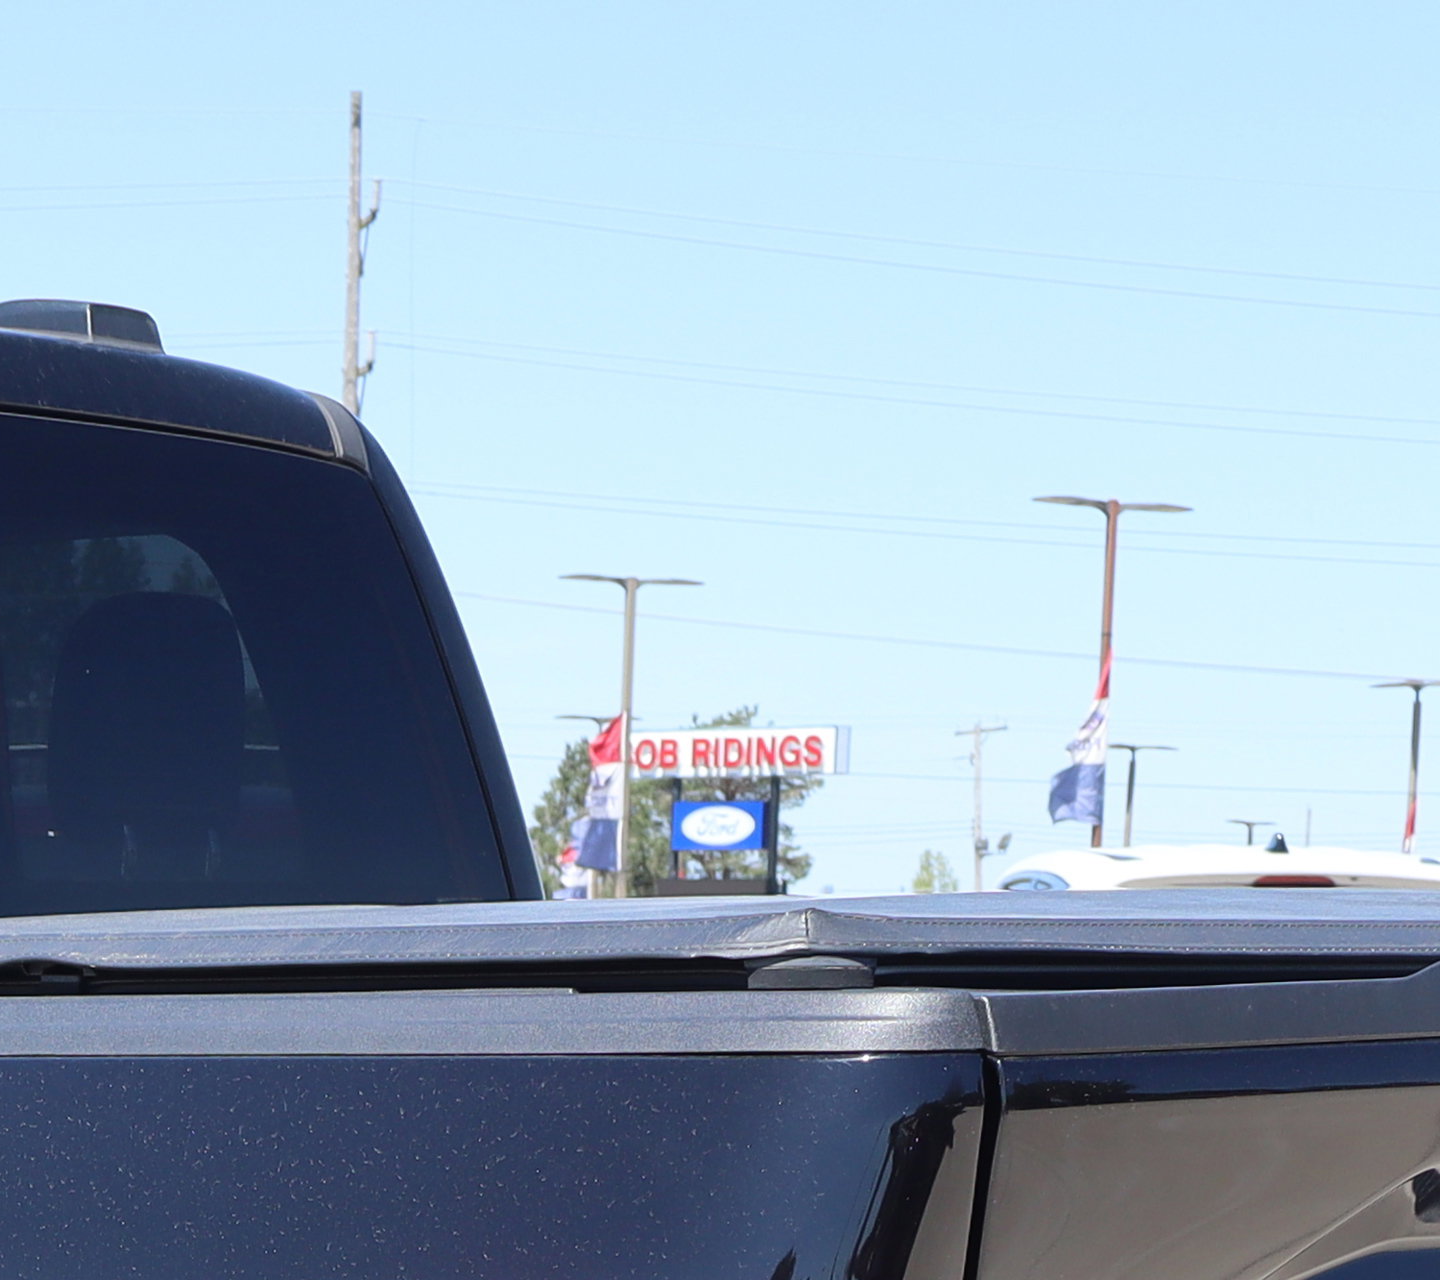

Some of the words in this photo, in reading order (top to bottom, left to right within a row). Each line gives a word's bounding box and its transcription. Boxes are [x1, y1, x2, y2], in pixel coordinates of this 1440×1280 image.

[629, 739, 679, 770] OB
[692, 735, 823, 768] RIDINGS
[697, 812, 740, 837] Ford
